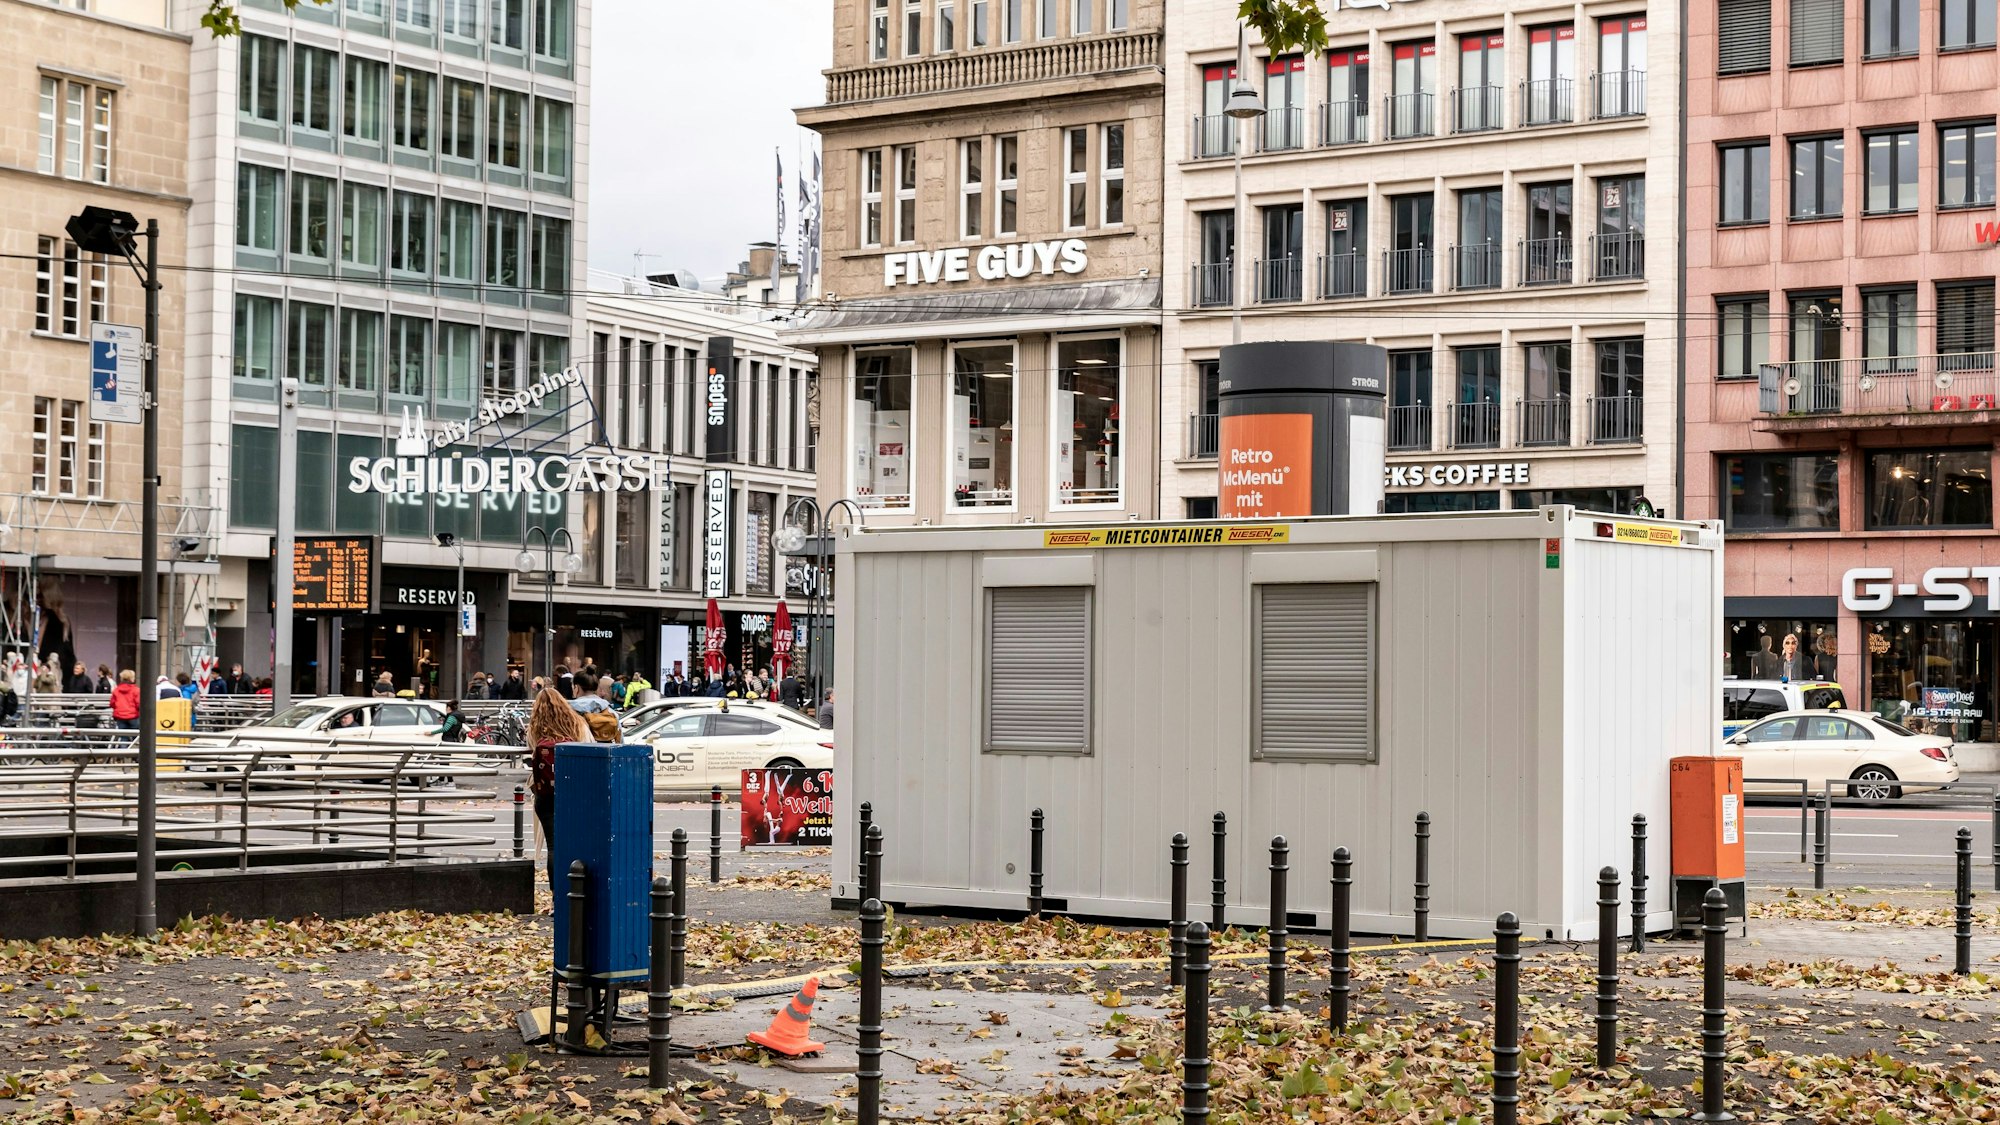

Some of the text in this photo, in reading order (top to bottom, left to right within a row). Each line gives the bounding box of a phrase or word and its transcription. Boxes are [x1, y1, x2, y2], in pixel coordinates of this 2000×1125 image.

[1606, 193, 1620, 205] 24
[1334, 217, 1347, 228] 24
[884, 238, 1088, 287] FIVE GUYS
[432, 363, 584, 448] city shopping
[708, 373, 728, 426] snipes
[1231, 448, 1273, 464] Retro
[348, 455, 670, 493] SCHILDERGASSE
[1429, 462, 1530, 485] COFFEE
[1236, 489, 1263, 507] mit
[710, 477, 724, 591] RESERVED
[1105, 528, 1223, 545] MIETCONTAINER
[741, 613, 767, 634] snipes
[580, 628, 613, 639] RESERVED
[1917, 707, 1983, 717] G-STAR RAW
[653, 749, 694, 764] bc
[1671, 763, 1690, 772] C64
[749, 771, 758, 783] 3
[803, 776, 819, 793] 6.
[803, 817, 825, 826] Jetzt
[797, 827, 807, 837] 2
